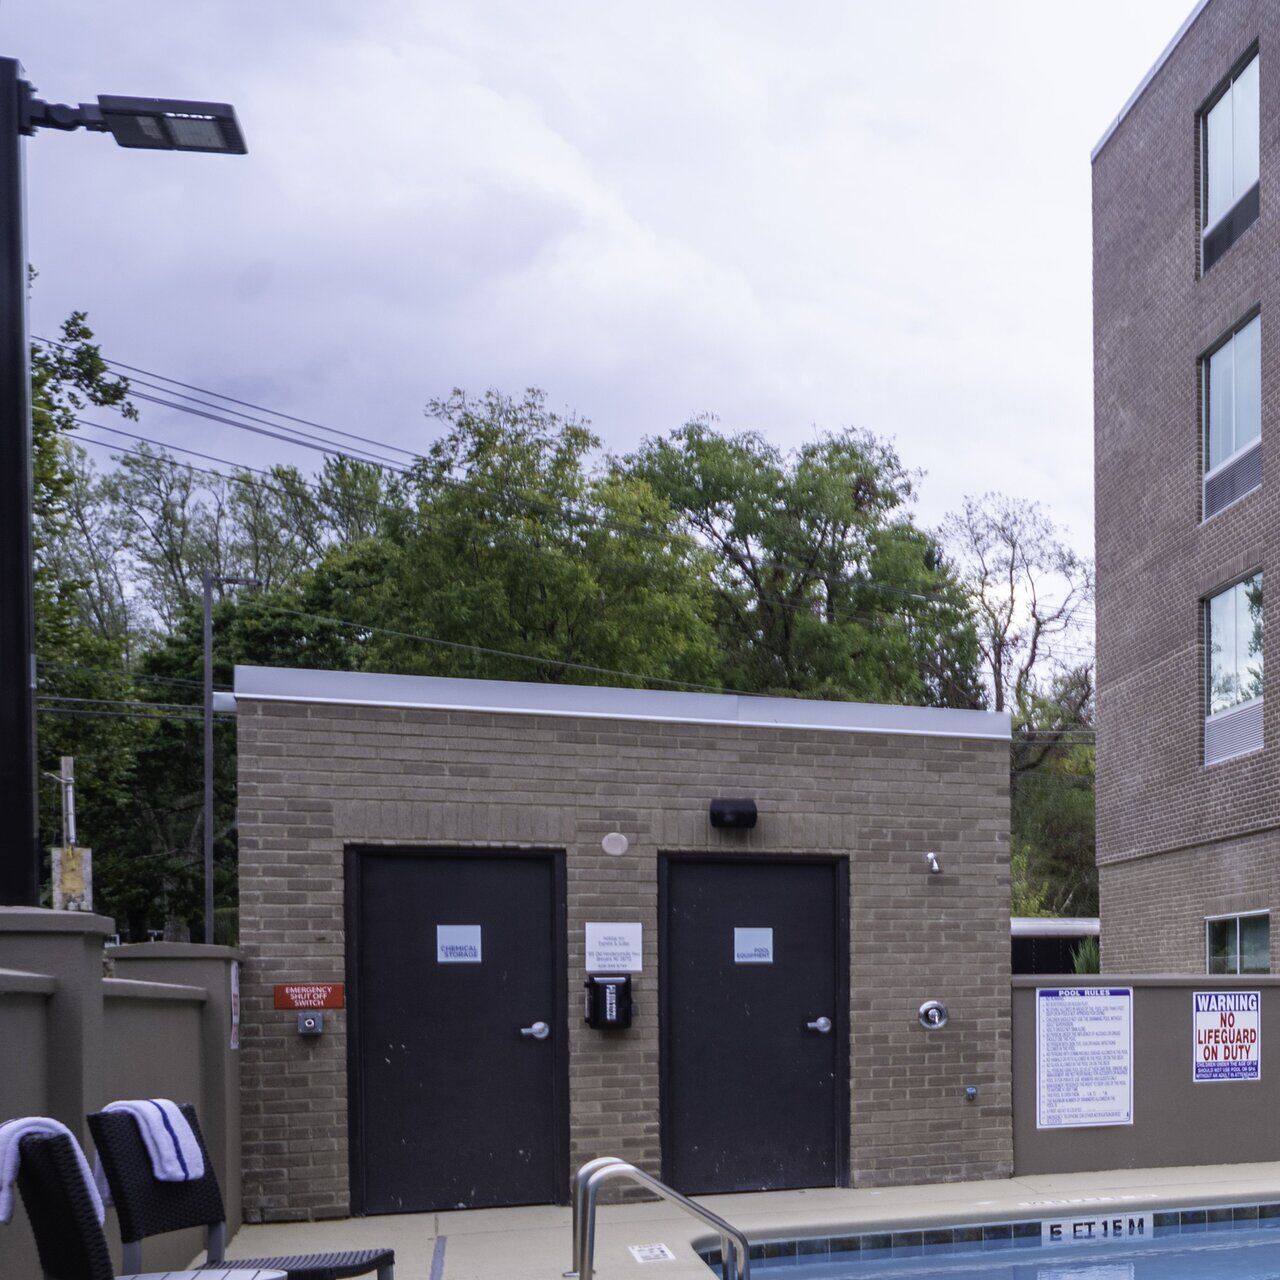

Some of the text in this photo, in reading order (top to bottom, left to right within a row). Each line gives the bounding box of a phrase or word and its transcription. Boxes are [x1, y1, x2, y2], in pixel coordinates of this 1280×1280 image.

[285, 986, 332, 994] EMERGENCY
[1197, 994, 1257, 1011] WARNING
[1220, 1012, 1235, 1028] NO
[1198, 1029, 1256, 1044] LIFEGUARD
[1203, 1044, 1251, 1061] ON DUTY
